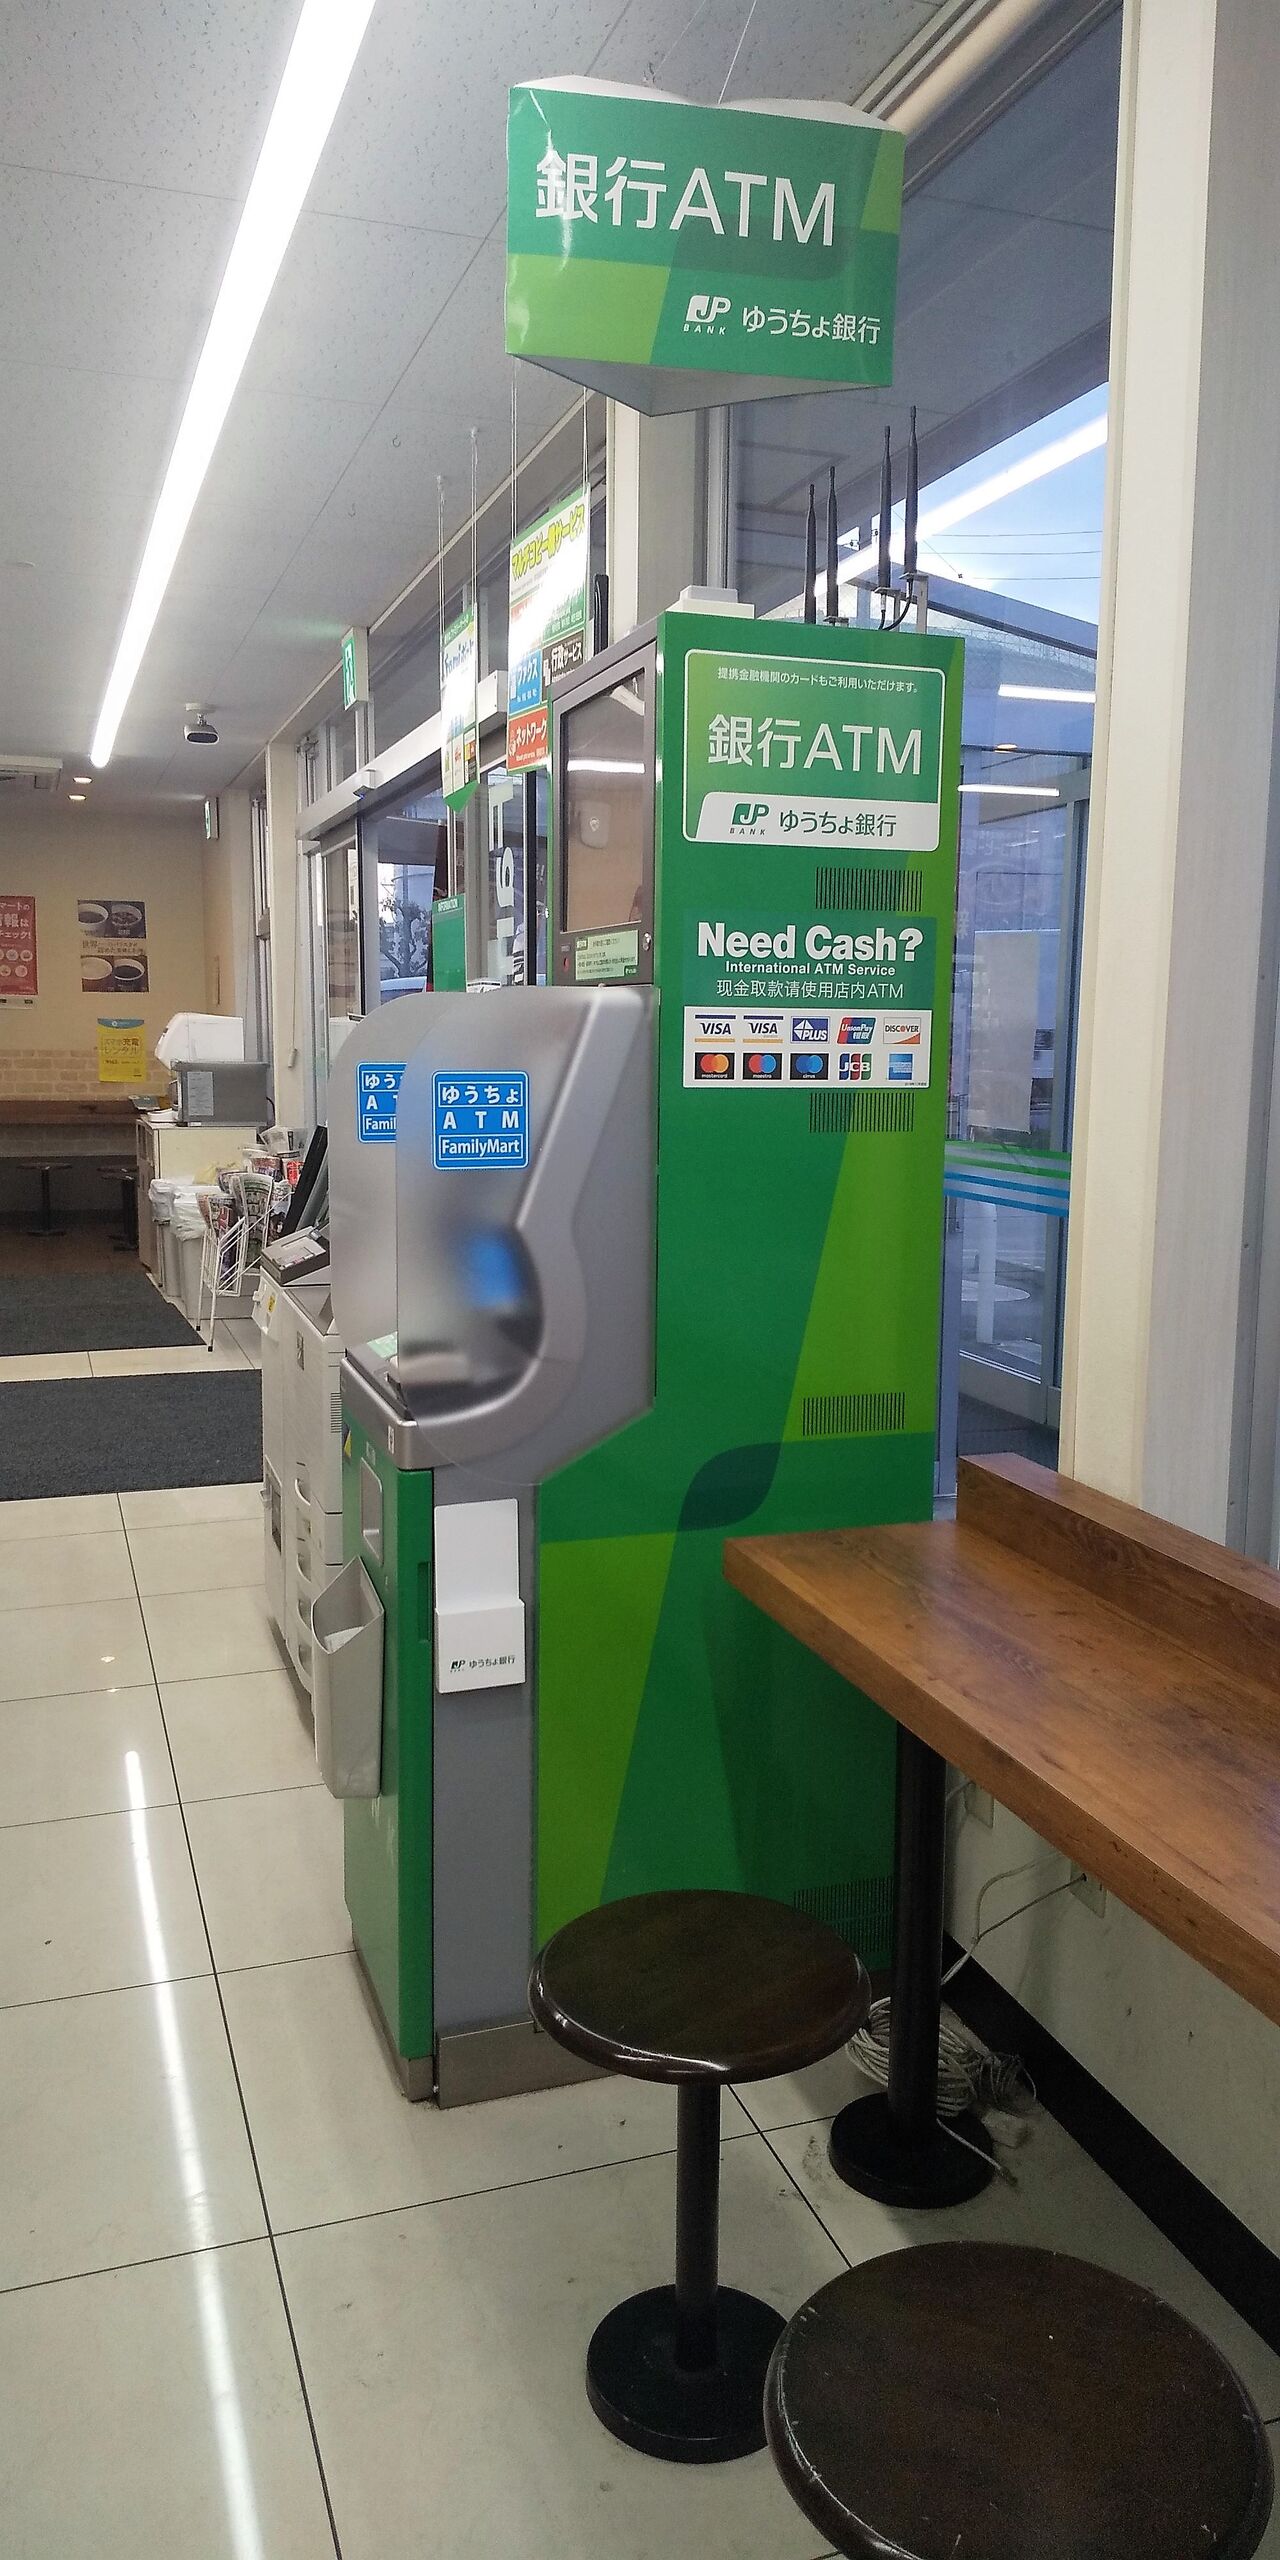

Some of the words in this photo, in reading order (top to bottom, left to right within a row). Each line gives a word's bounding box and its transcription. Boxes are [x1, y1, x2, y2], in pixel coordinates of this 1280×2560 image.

[535, 150, 836, 247] 銀行ATM
[683, 324, 727, 336] BANK
[742, 305, 881, 345] ゆうちょ銀行
[717, 666, 918, 693] 提携金融機関のカードもご利用いただけます。
[708, 713, 922, 775] 銀行ATM
[729, 828, 766, 836] BANK
[779, 810, 897, 837] ゆうちょ銀行
[0, 913, 29, 928] 報は
[697, 921, 796, 959] Need
[805, 925, 924, 962] Cash?
[725, 960, 810, 975] International
[814, 963, 844, 975] ATM
[848, 964, 896, 976] Service
[716, 979, 904, 999] 现金取款请使用店内ATM
[700, 1022, 732, 1035] VISA
[748, 1022, 778, 1034] VISA
[801, 1029, 828, 1041] PLUS
[839, 1062, 871, 1071] JCB
[365, 1072, 404, 1089] ゆう
[441, 1084, 519, 1104] ゆうちょ
[441, 1138, 520, 1157] FamilyMart
[469, 1655, 516, 1668] ゆうちょ銀行
